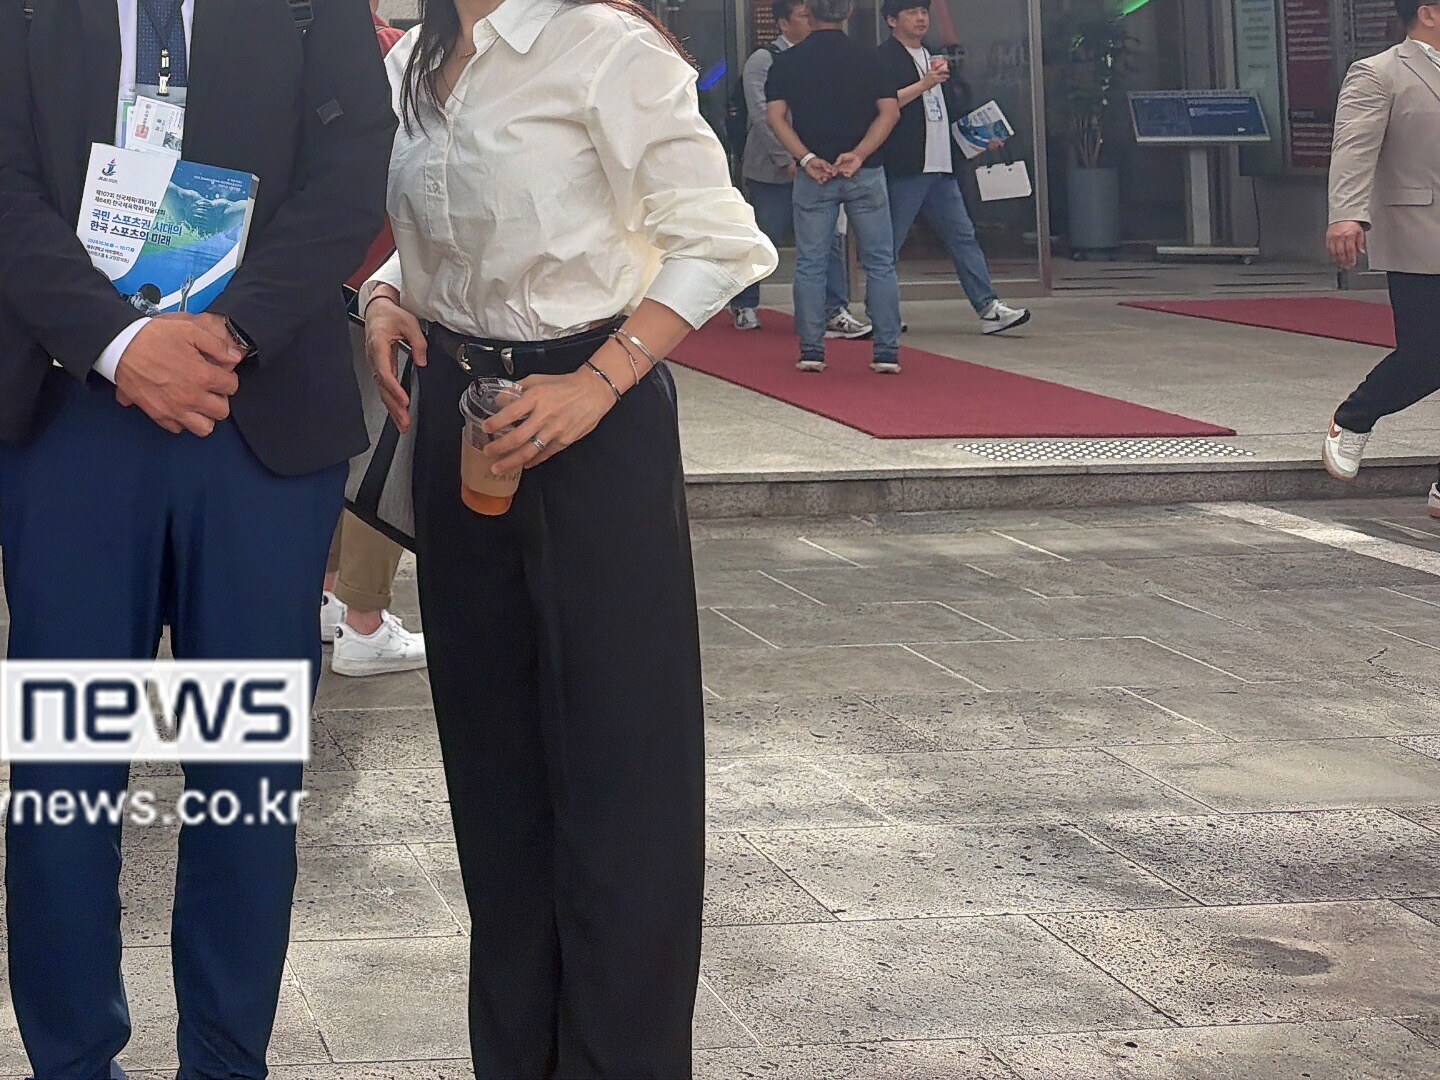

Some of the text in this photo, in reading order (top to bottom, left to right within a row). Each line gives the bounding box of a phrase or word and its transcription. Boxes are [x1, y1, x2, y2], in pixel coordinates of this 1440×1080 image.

[90, 220, 109, 234] 한국
[110, 225, 149, 242] 스포츠의
[151, 233, 172, 247] 미래
[92, 208, 182, 237] 국민 스포츠권 시대의
